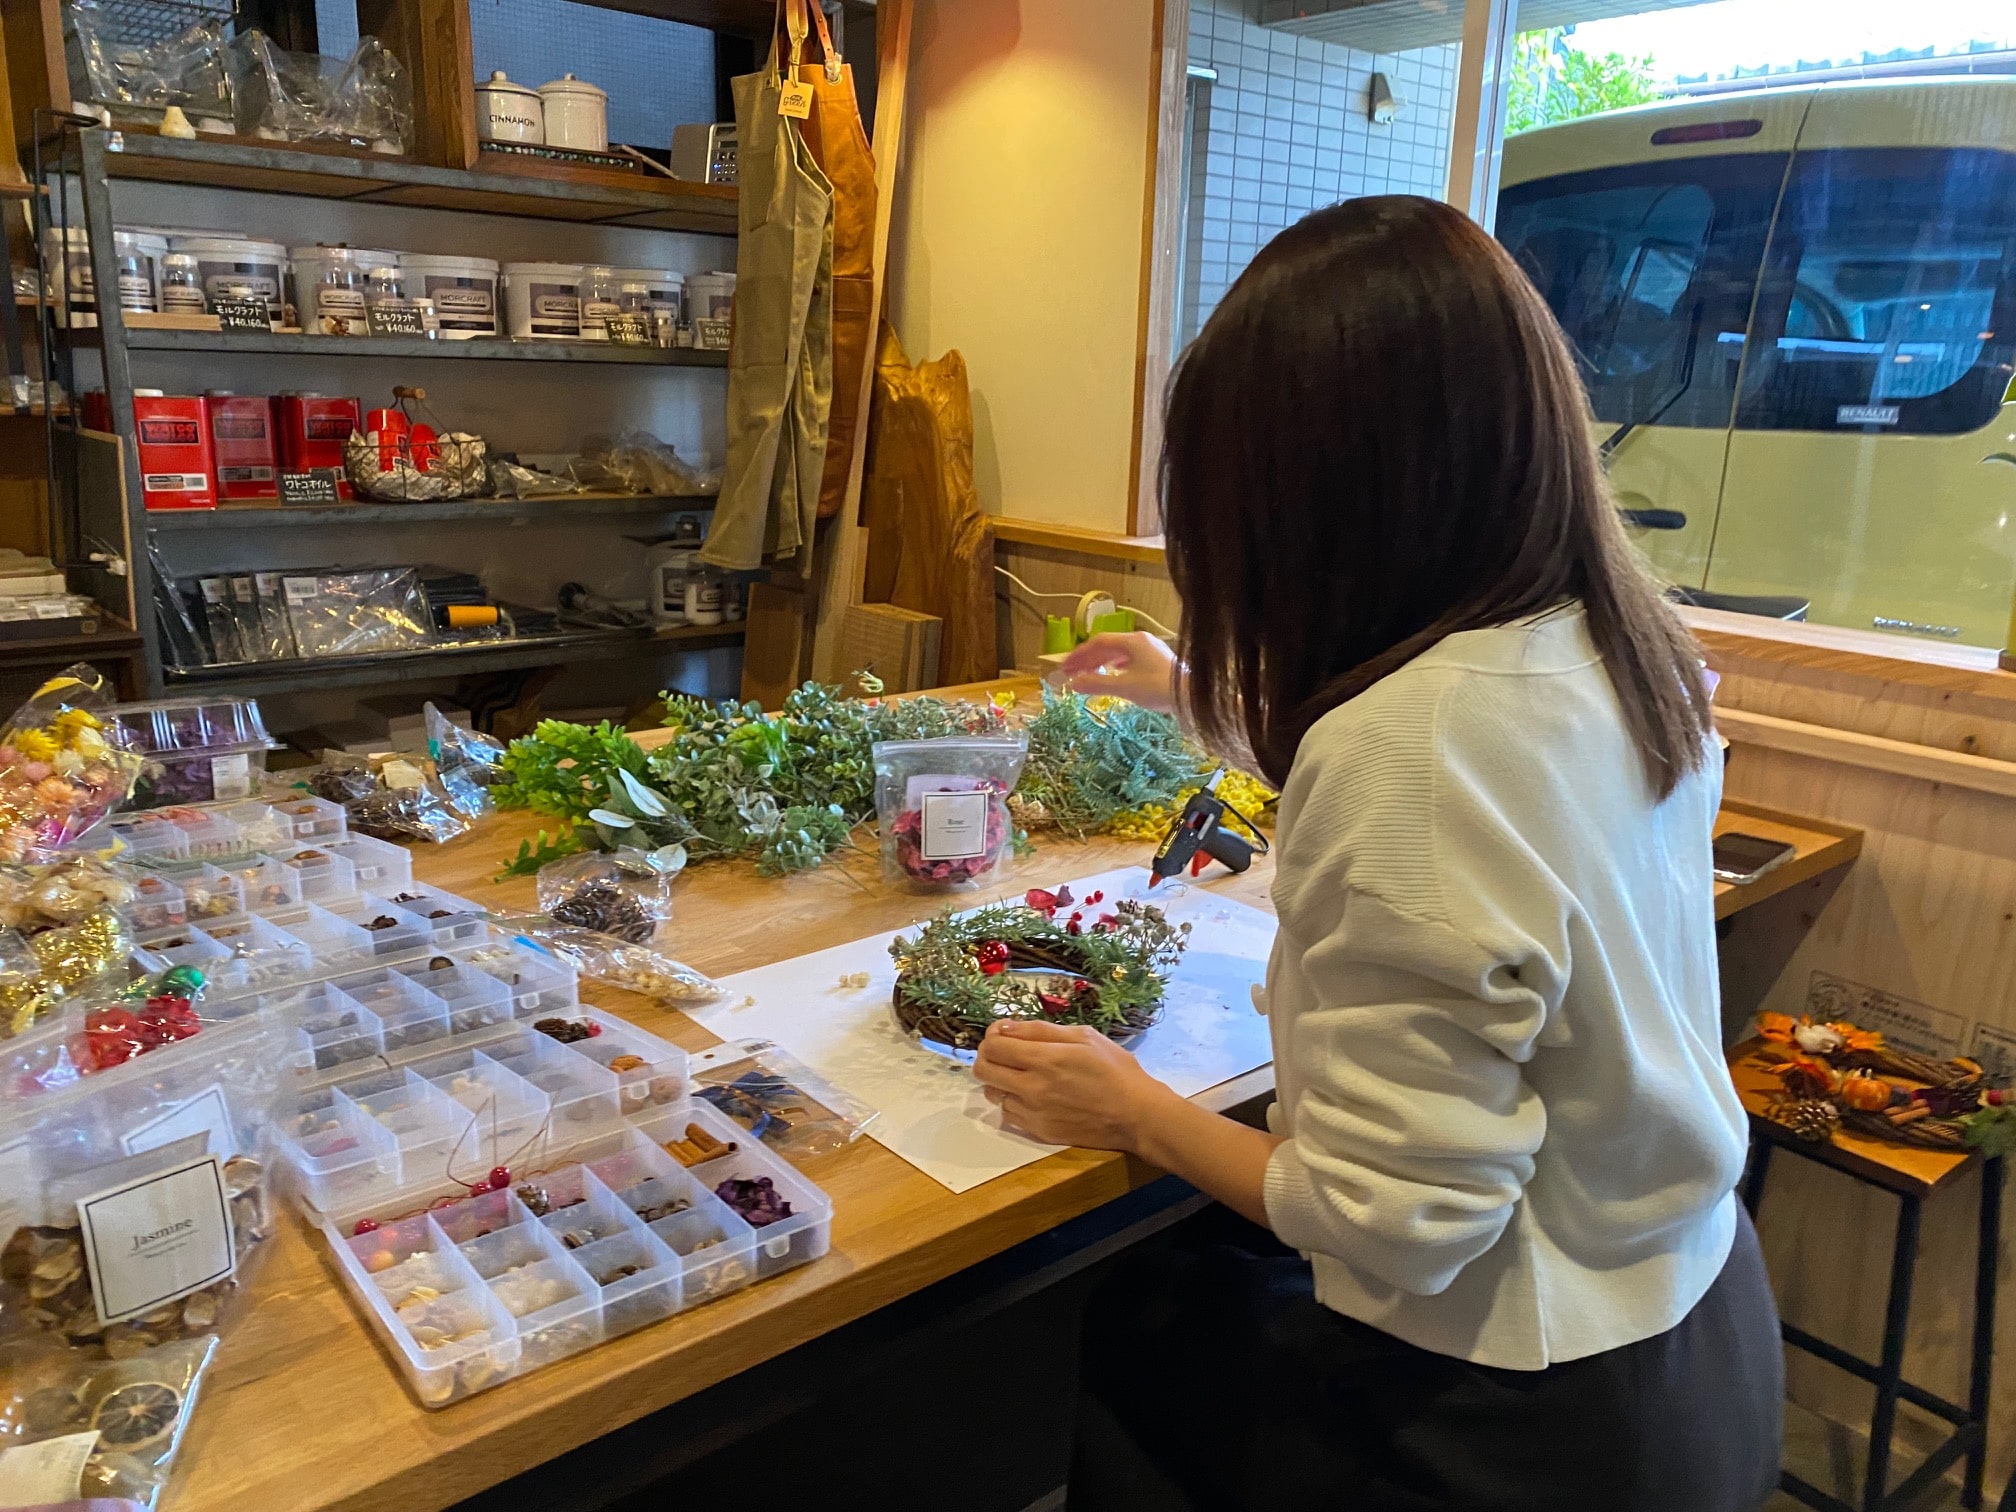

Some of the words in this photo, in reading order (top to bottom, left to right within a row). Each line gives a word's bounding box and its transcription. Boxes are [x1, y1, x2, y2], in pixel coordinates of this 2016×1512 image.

[489, 114, 535, 127] CINNAMON
[440, 294, 486, 303] MORCRAFT
[543, 300, 578, 308] MORCRA
[215, 305, 263, 316] モルクラフト
[374, 313, 416, 323] モルクラフト
[285, 479, 332, 489] ワトコオイル
[130, 1218, 194, 1251] Jasmine
